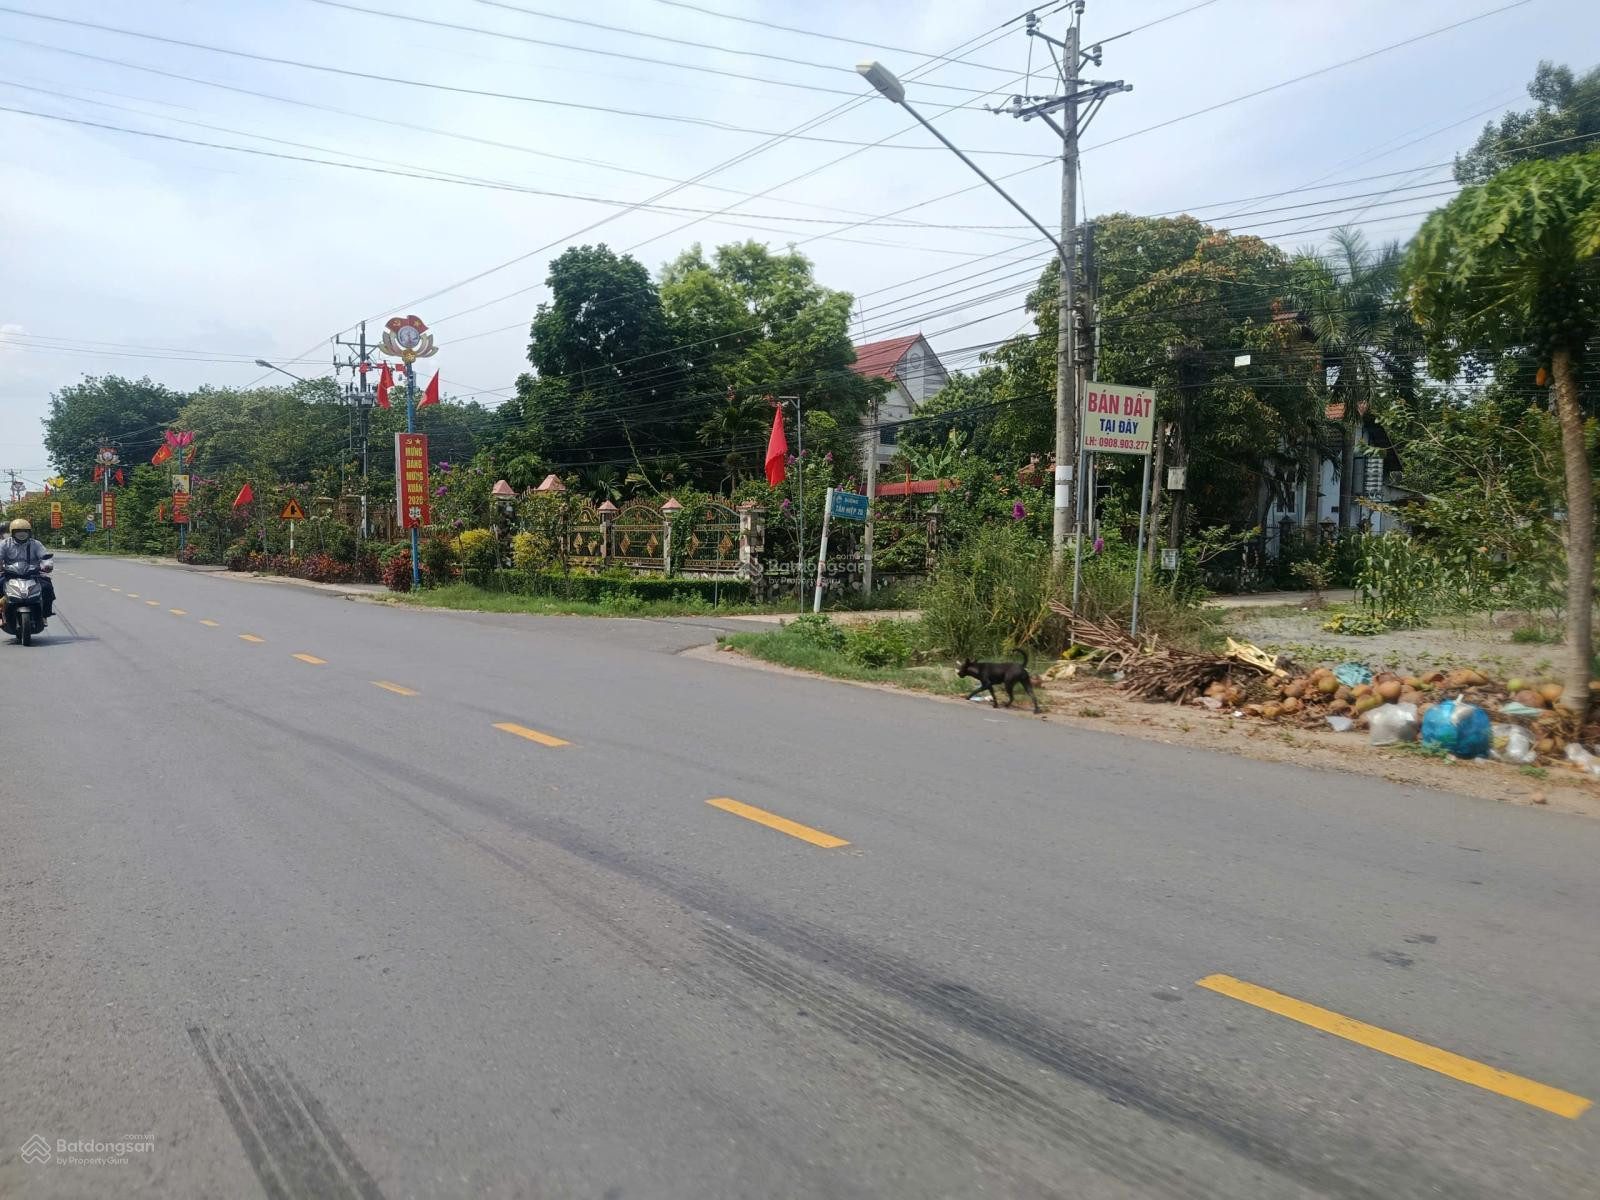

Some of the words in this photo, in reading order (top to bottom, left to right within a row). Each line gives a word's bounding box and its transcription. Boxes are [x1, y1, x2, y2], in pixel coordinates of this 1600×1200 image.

[1088, 389, 1120, 415] BÁN
[1124, 391, 1152, 418] ĐẤT
[1100, 418, 1116, 435] TẠI
[1118, 418, 1139, 435] ĐÂY
[1085, 436, 1097, 447] LH:
[1099, 437, 1150, 451] 0908.903.277
